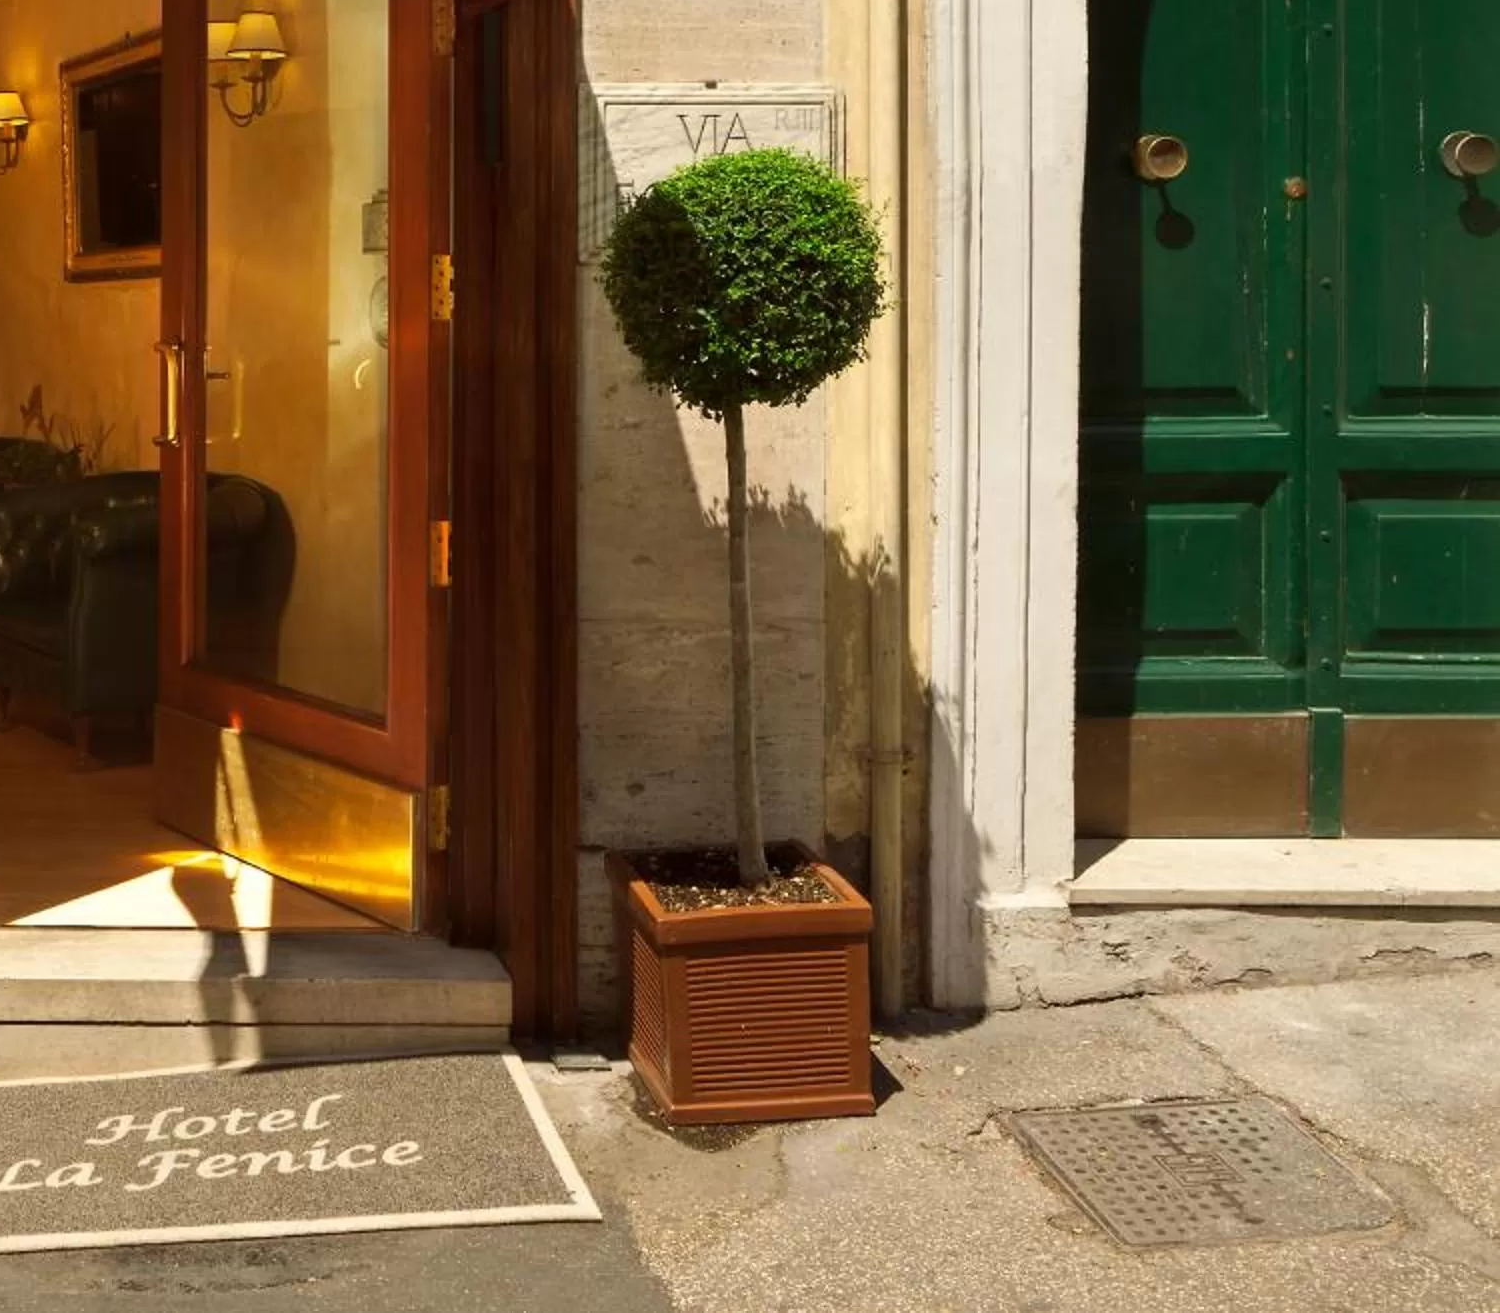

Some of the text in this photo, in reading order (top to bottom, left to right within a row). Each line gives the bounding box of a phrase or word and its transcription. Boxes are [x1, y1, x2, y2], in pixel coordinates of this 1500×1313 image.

[676, 112, 752, 156] VIA
[85, 1094, 342, 1145] Hotel
[124, 1138, 423, 1191] Fenice
